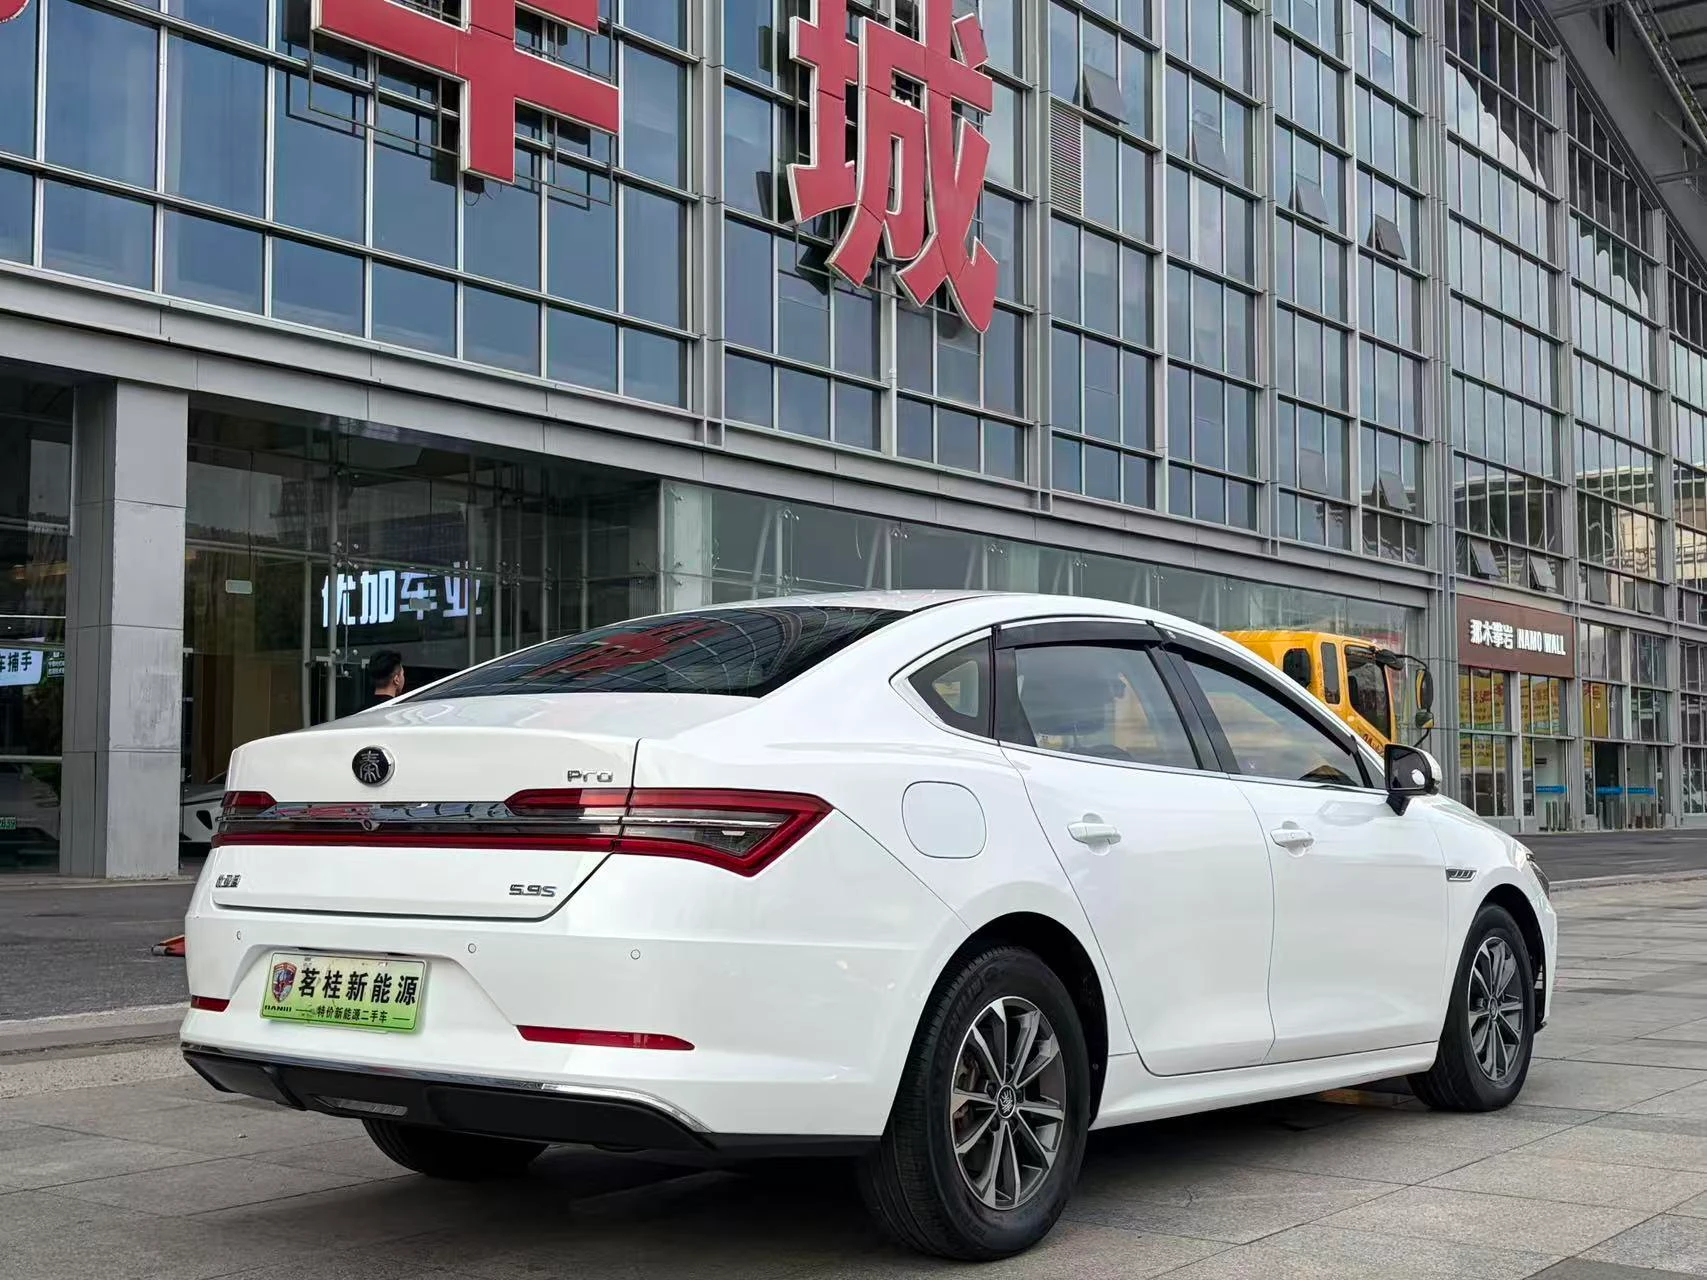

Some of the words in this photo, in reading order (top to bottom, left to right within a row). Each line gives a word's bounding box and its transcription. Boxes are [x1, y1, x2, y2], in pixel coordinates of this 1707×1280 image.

[321, 560, 483, 628] 优加车业
[1516, 627, 1542, 652] NAMO
[1543, 632, 1566, 656] WALL
[566, 770, 613, 783] Pro
[298, 967, 419, 1006] 茗桂新能源
[316, 1005, 388, 1023] 特价新能源二手车
